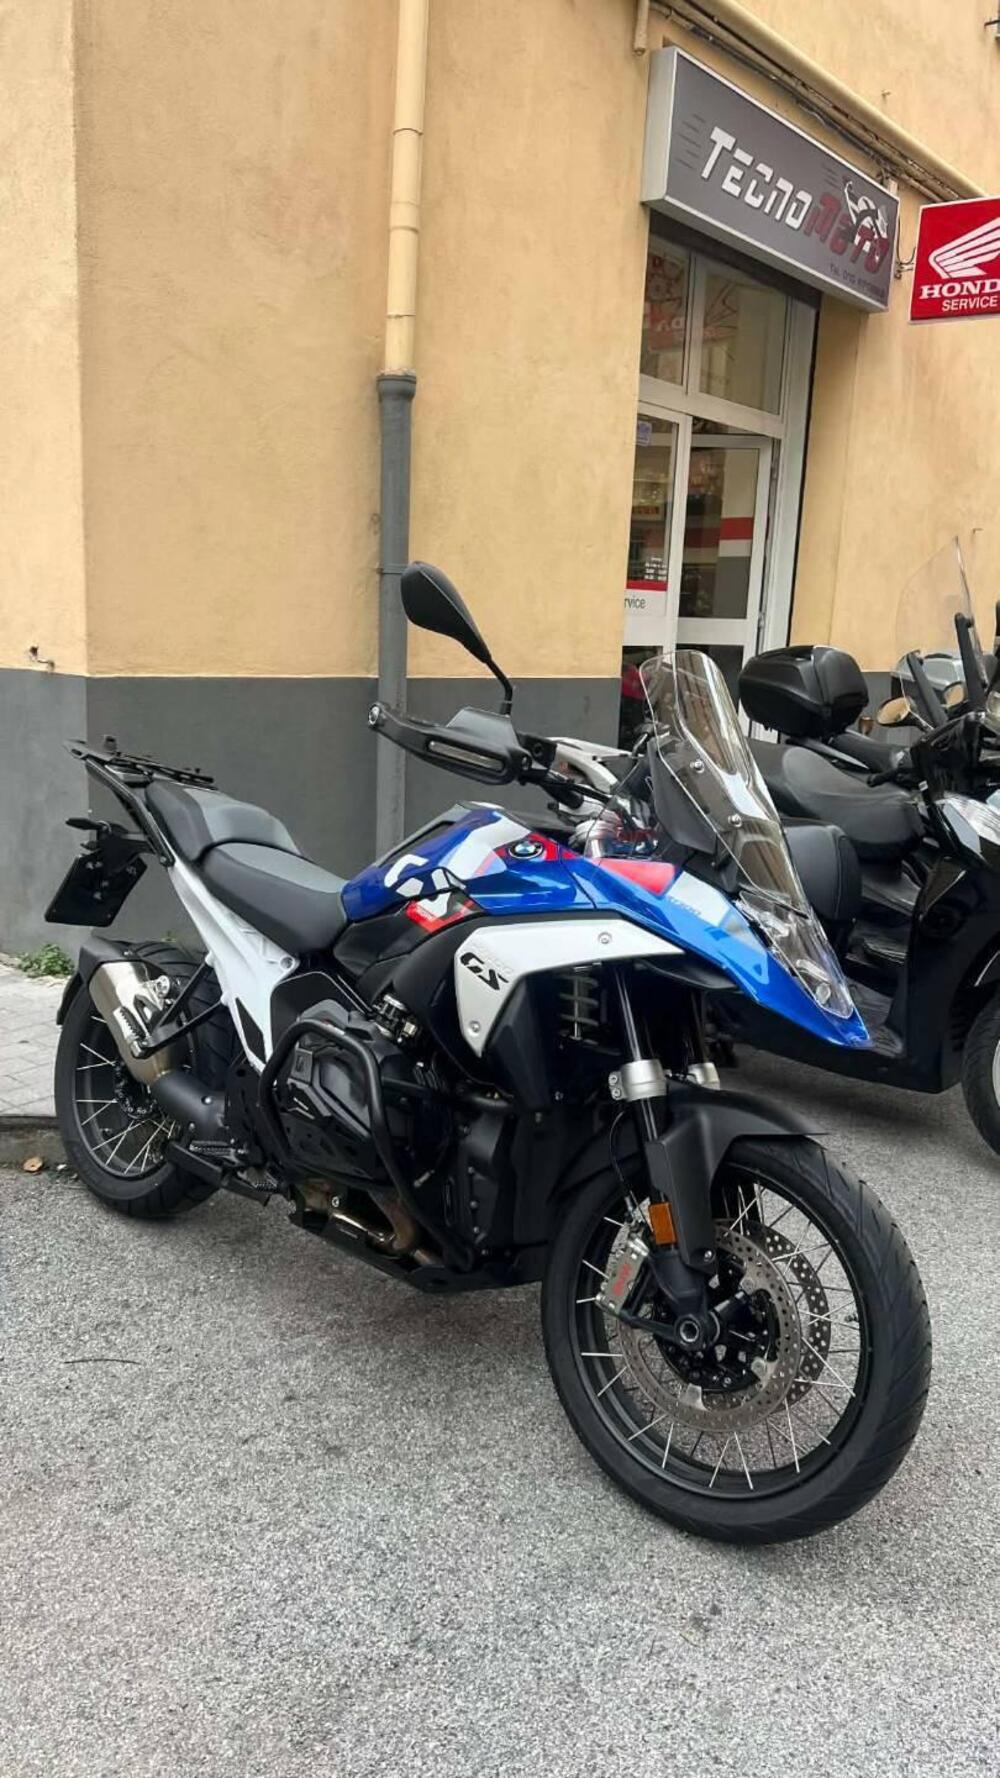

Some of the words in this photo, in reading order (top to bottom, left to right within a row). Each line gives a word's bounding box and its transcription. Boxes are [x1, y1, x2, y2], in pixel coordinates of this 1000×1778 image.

[920, 279, 1000, 299] HOND
[942, 296, 998, 311] SERVICE
[460, 952, 509, 991] GS
